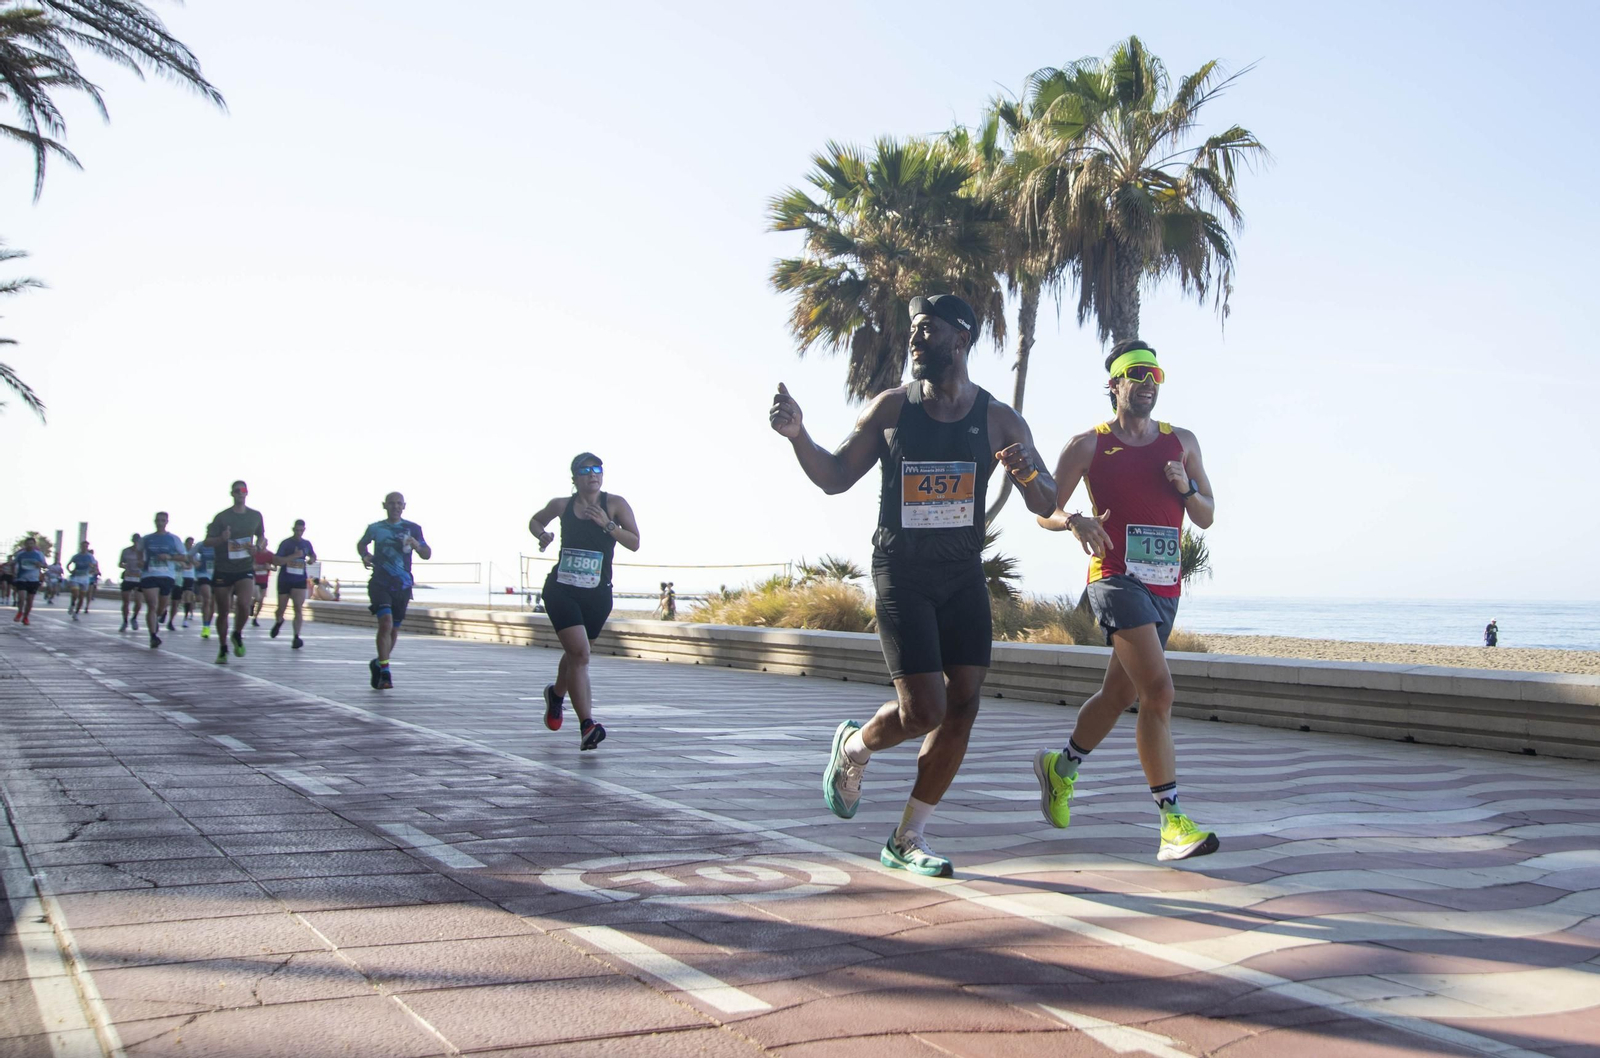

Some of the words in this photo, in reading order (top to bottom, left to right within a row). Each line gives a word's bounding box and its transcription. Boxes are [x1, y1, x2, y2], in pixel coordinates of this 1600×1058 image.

[968, 425, 980, 435] NB
[918, 474, 961, 495] 457
[1141, 537, 1177, 556] 199
[566, 556, 599, 570] 1580
